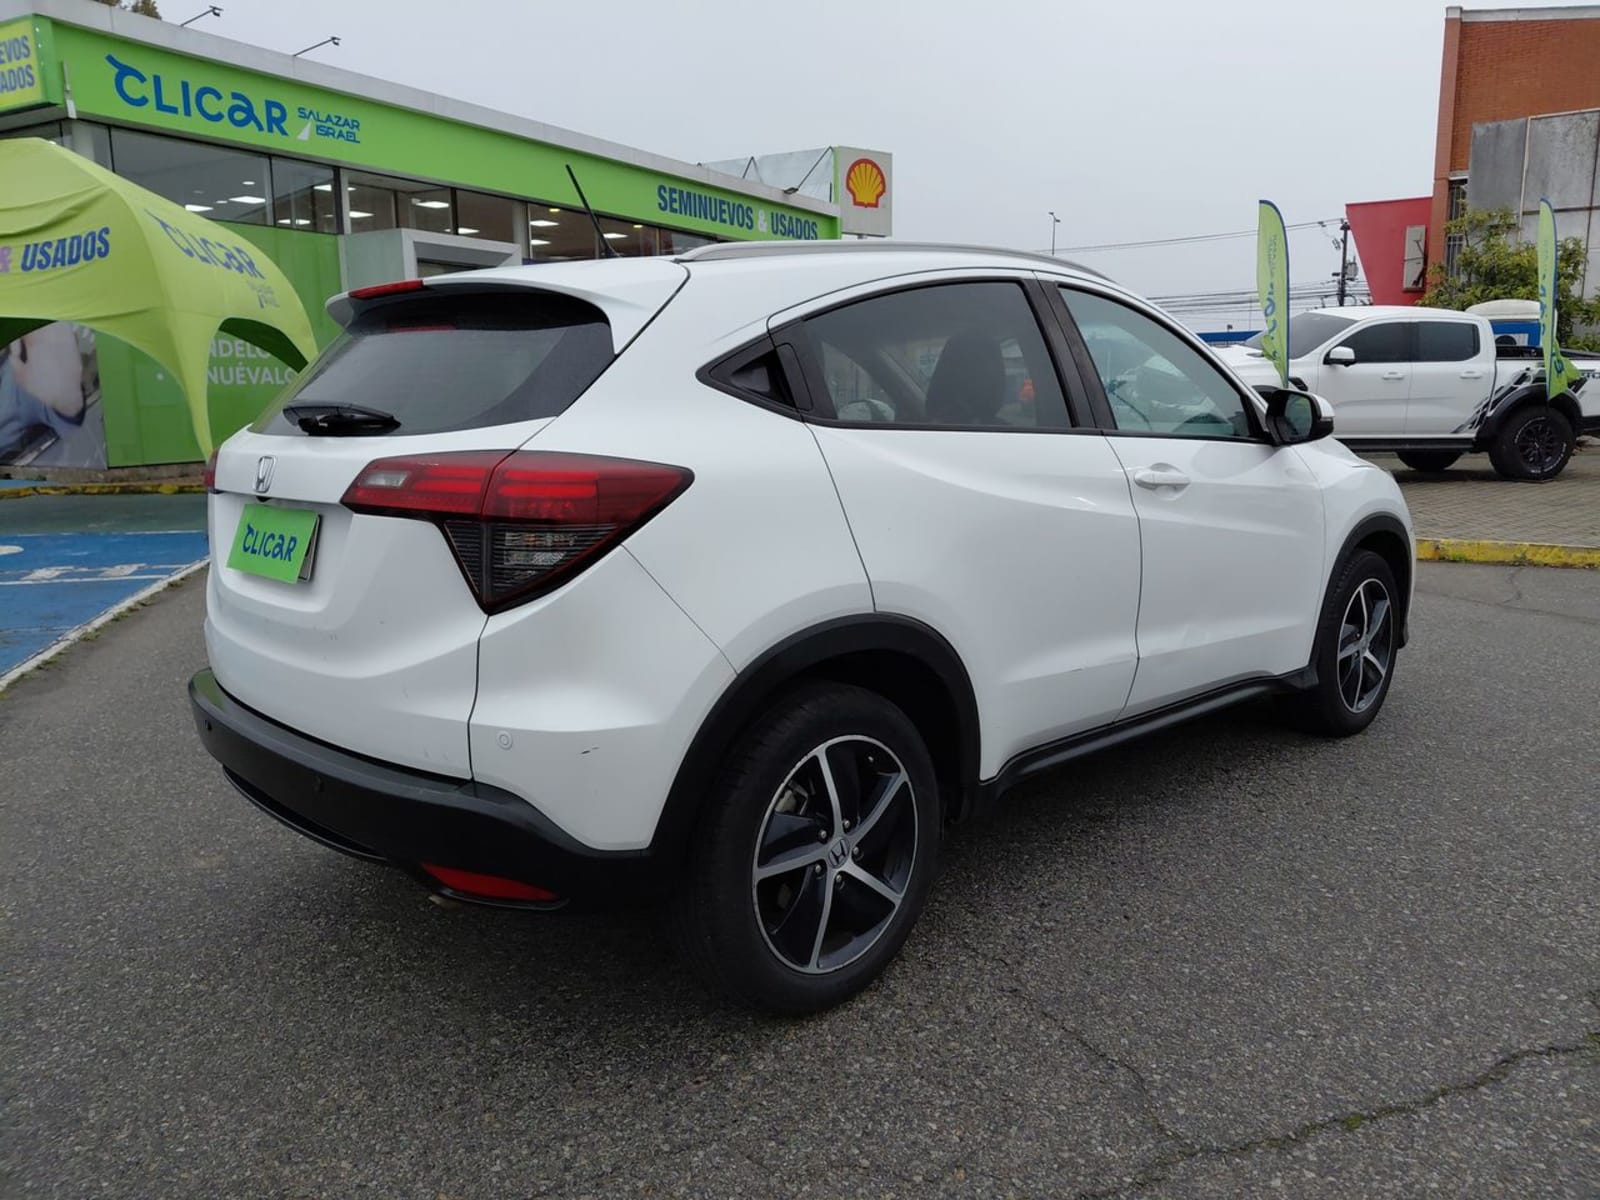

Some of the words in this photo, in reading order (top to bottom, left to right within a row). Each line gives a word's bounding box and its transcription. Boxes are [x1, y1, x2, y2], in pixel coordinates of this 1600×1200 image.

[297, 106, 360, 131] SALAZAR
[315, 125, 361, 144] ISRAEL
[657, 185, 754, 231] SEMINUEVOS
[770, 212, 818, 240] USADOS
[21, 226, 110, 272] USADOS
